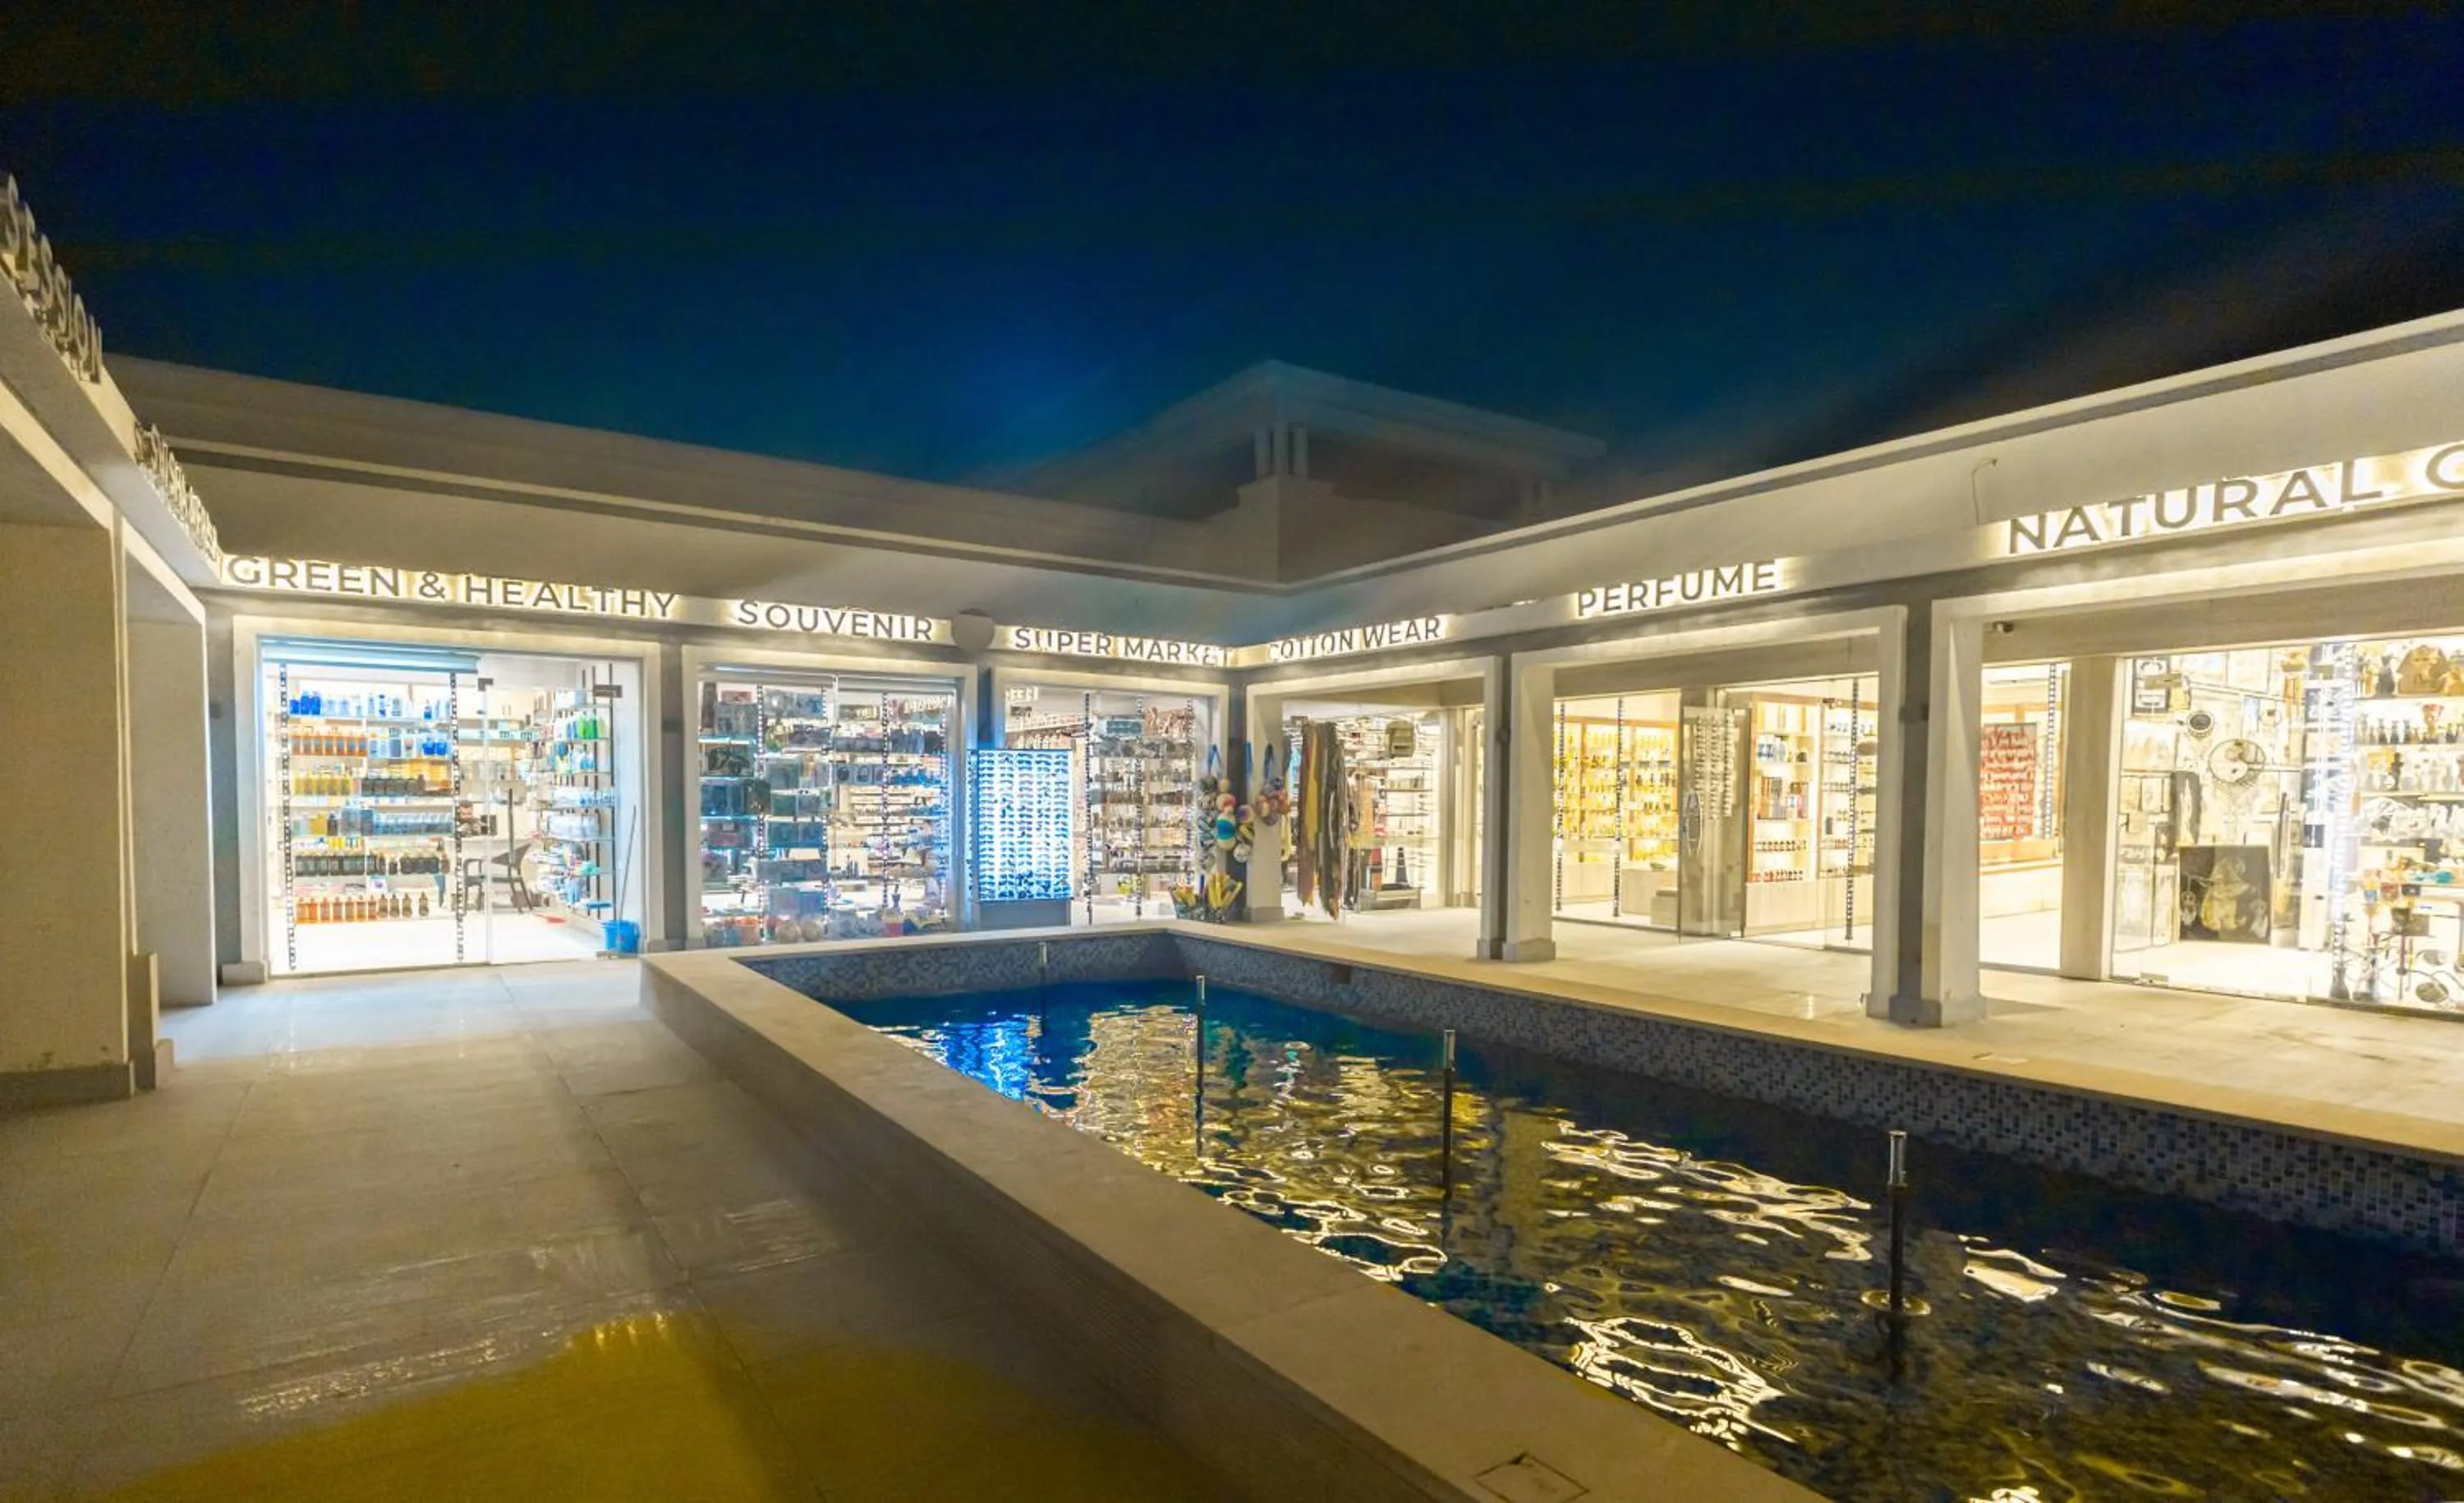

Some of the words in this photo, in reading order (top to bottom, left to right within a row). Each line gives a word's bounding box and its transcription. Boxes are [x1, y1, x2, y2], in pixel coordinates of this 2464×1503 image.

[2009, 459, 2384, 554] NATURAL
[227, 556, 401, 597] GREEN
[417, 571, 446, 600] &
[464, 573, 677, 618] HEALTHY
[1577, 560, 1777, 618] PERFUME
[737, 600, 933, 641] SOUVENIR
[1014, 627, 1112, 655] SUPER
[1362, 616, 1441, 647] WEAR
